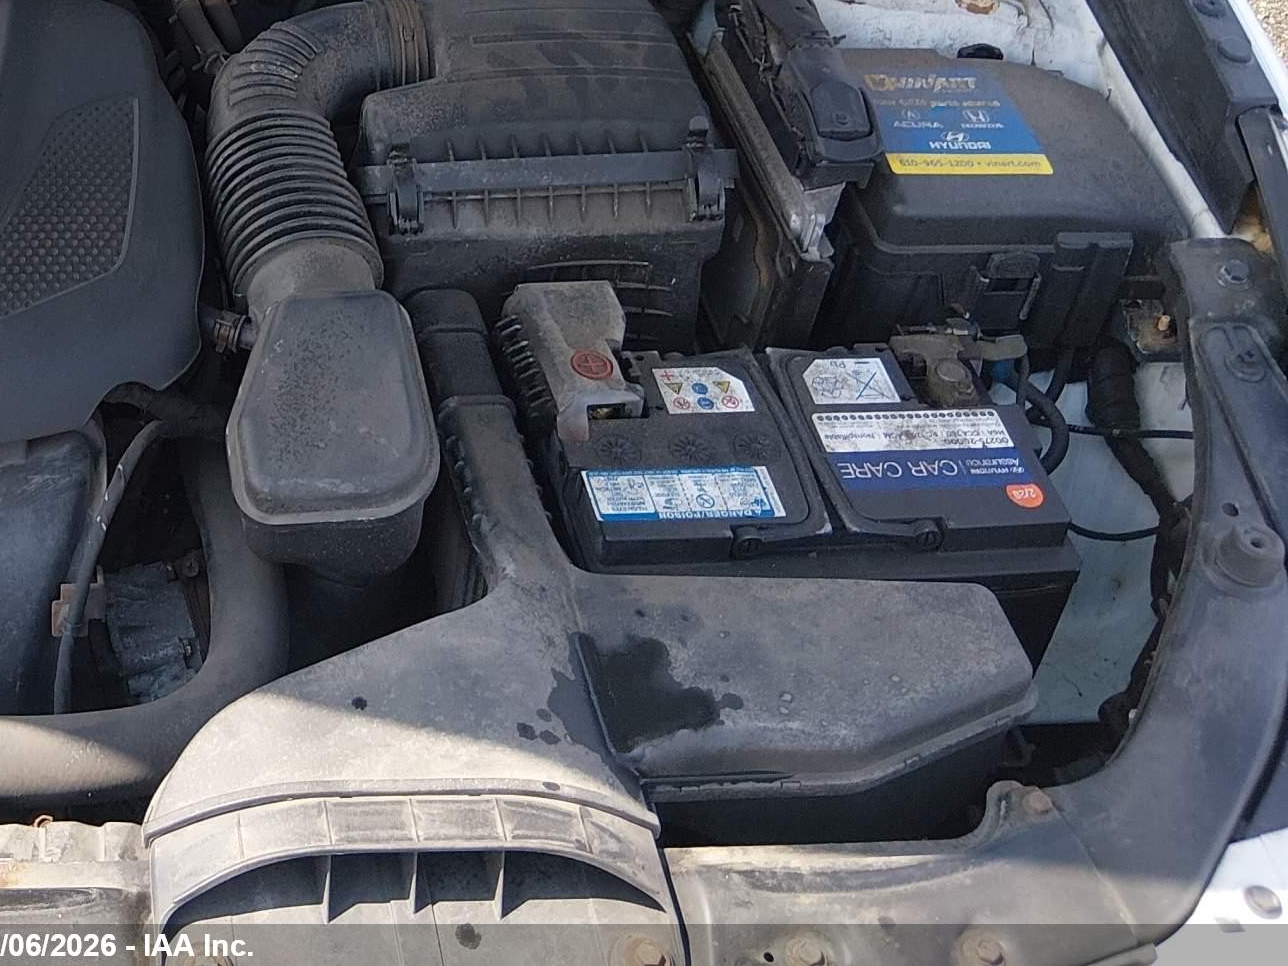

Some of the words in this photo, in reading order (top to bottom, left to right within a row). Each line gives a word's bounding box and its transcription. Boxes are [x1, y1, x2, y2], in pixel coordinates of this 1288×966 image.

[893, 121, 944, 129] ACURA
[929, 141, 991, 150] HYUNDAI
[965, 458, 1019, 467] Assurance
[837, 461, 903, 479] CARE
[907, 459, 958, 477] CAR
